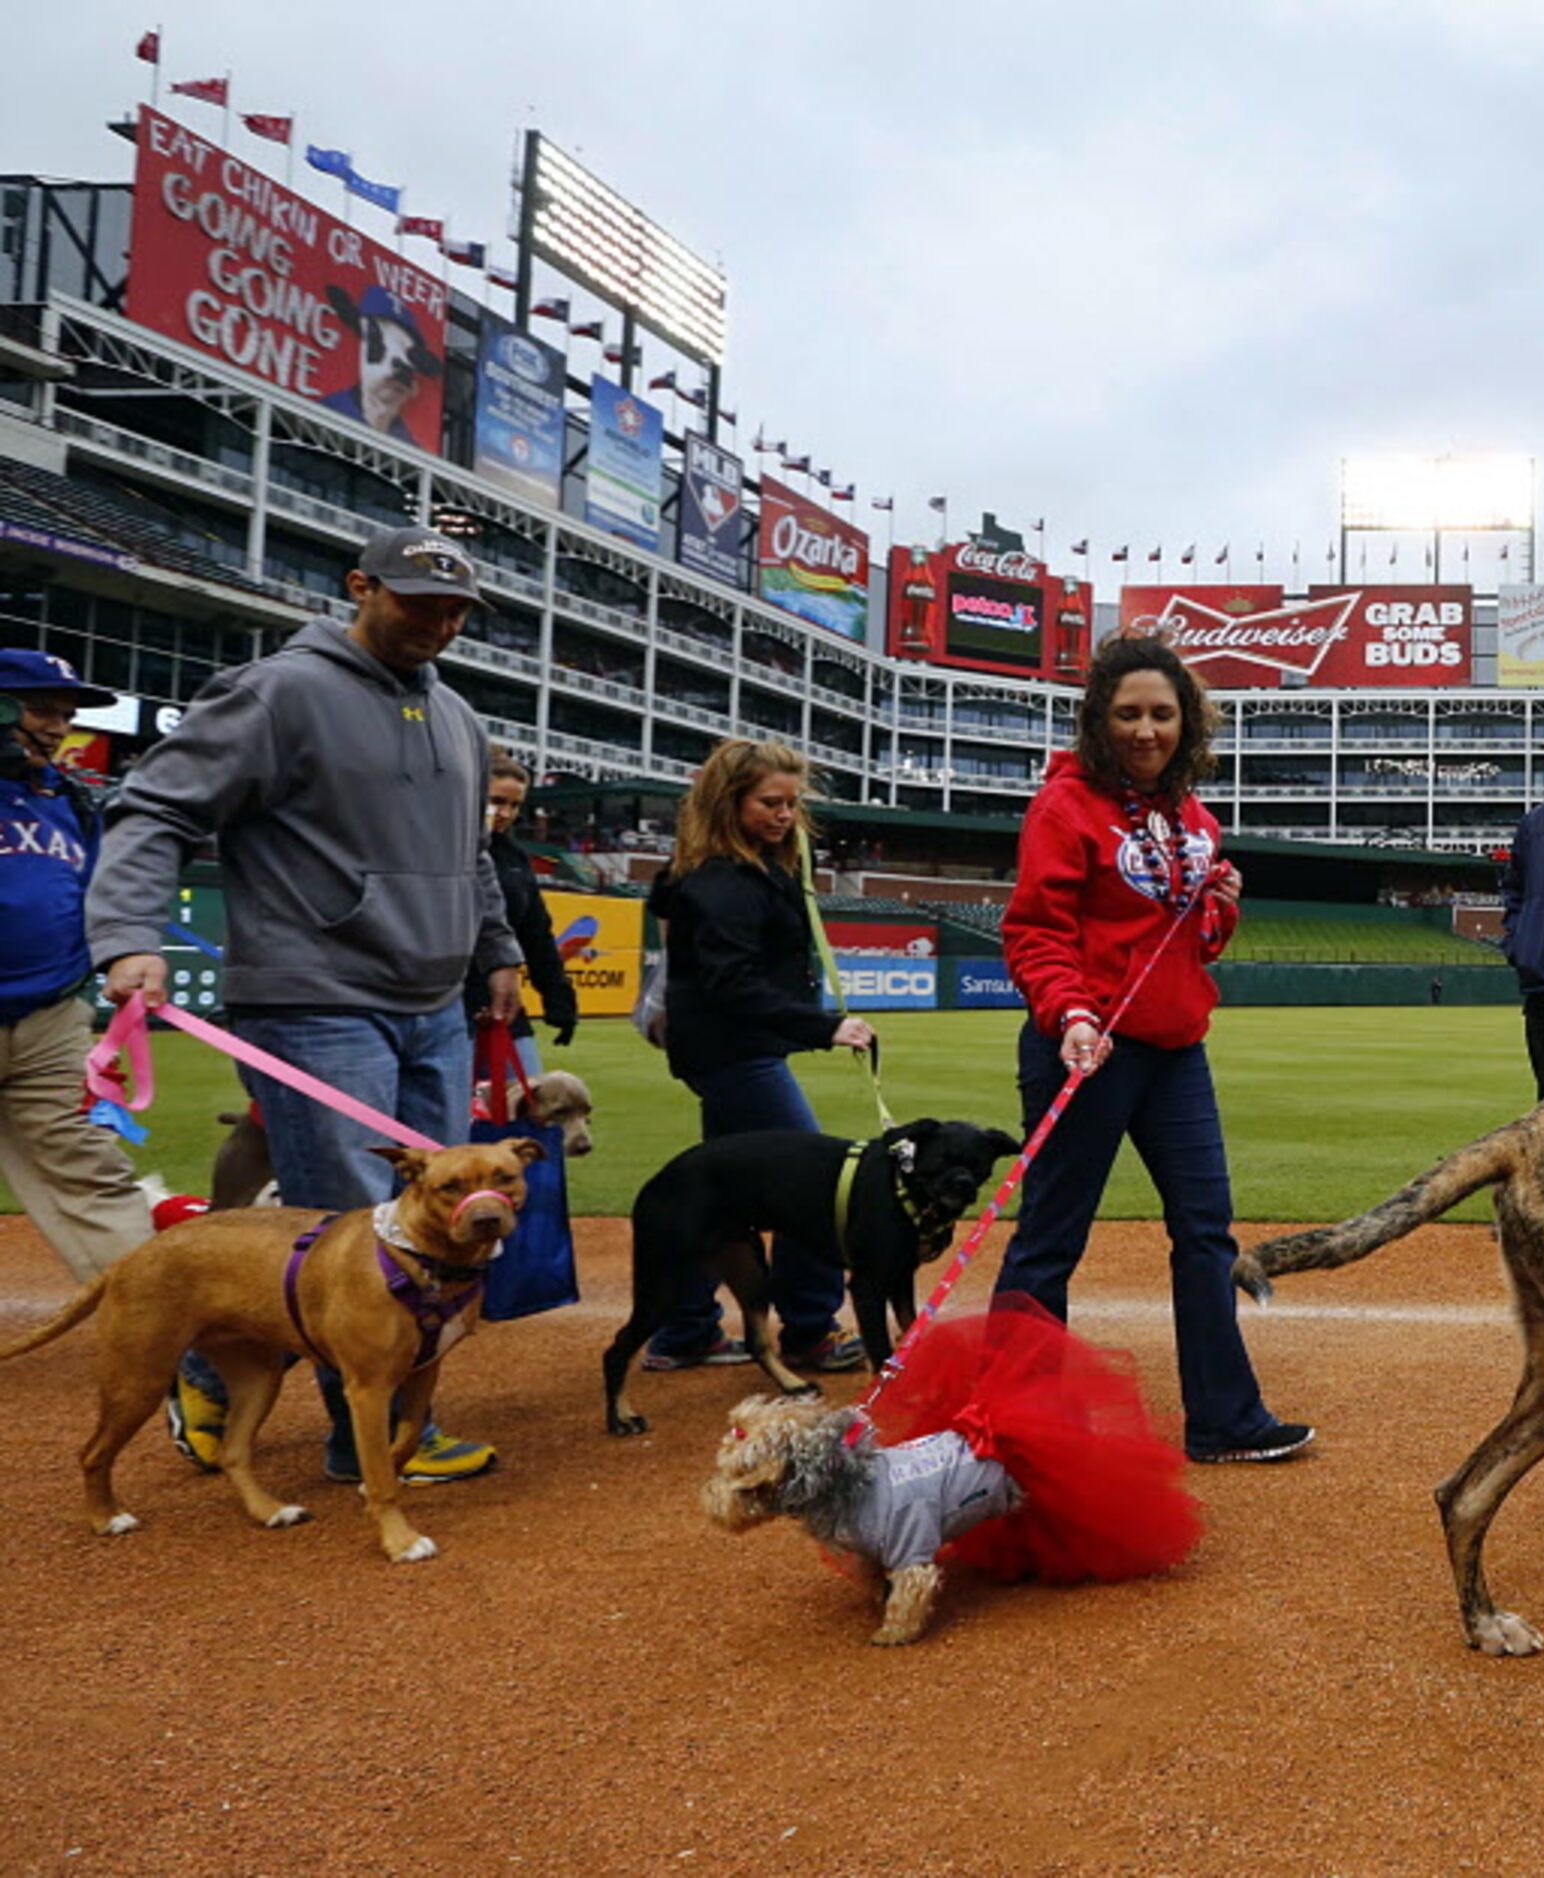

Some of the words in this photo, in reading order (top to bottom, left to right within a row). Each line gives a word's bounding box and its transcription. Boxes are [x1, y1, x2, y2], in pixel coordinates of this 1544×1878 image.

[151, 119, 213, 173] EAT
[222, 159, 318, 246] CHIKIN
[328, 228, 365, 269] OR
[162, 171, 294, 277] GOING
[208, 247, 340, 349] GOING
[186, 289, 321, 395] GONE
[690, 441, 738, 488] MLB
[772, 515, 859, 574] Ozarka
[1131, 614, 1347, 647] Budweiser
[1365, 603, 1464, 626] GRAB
[1383, 626, 1446, 642] SOME
[1365, 643, 1463, 667] BUDS
[825, 970, 936, 995] GEICO
